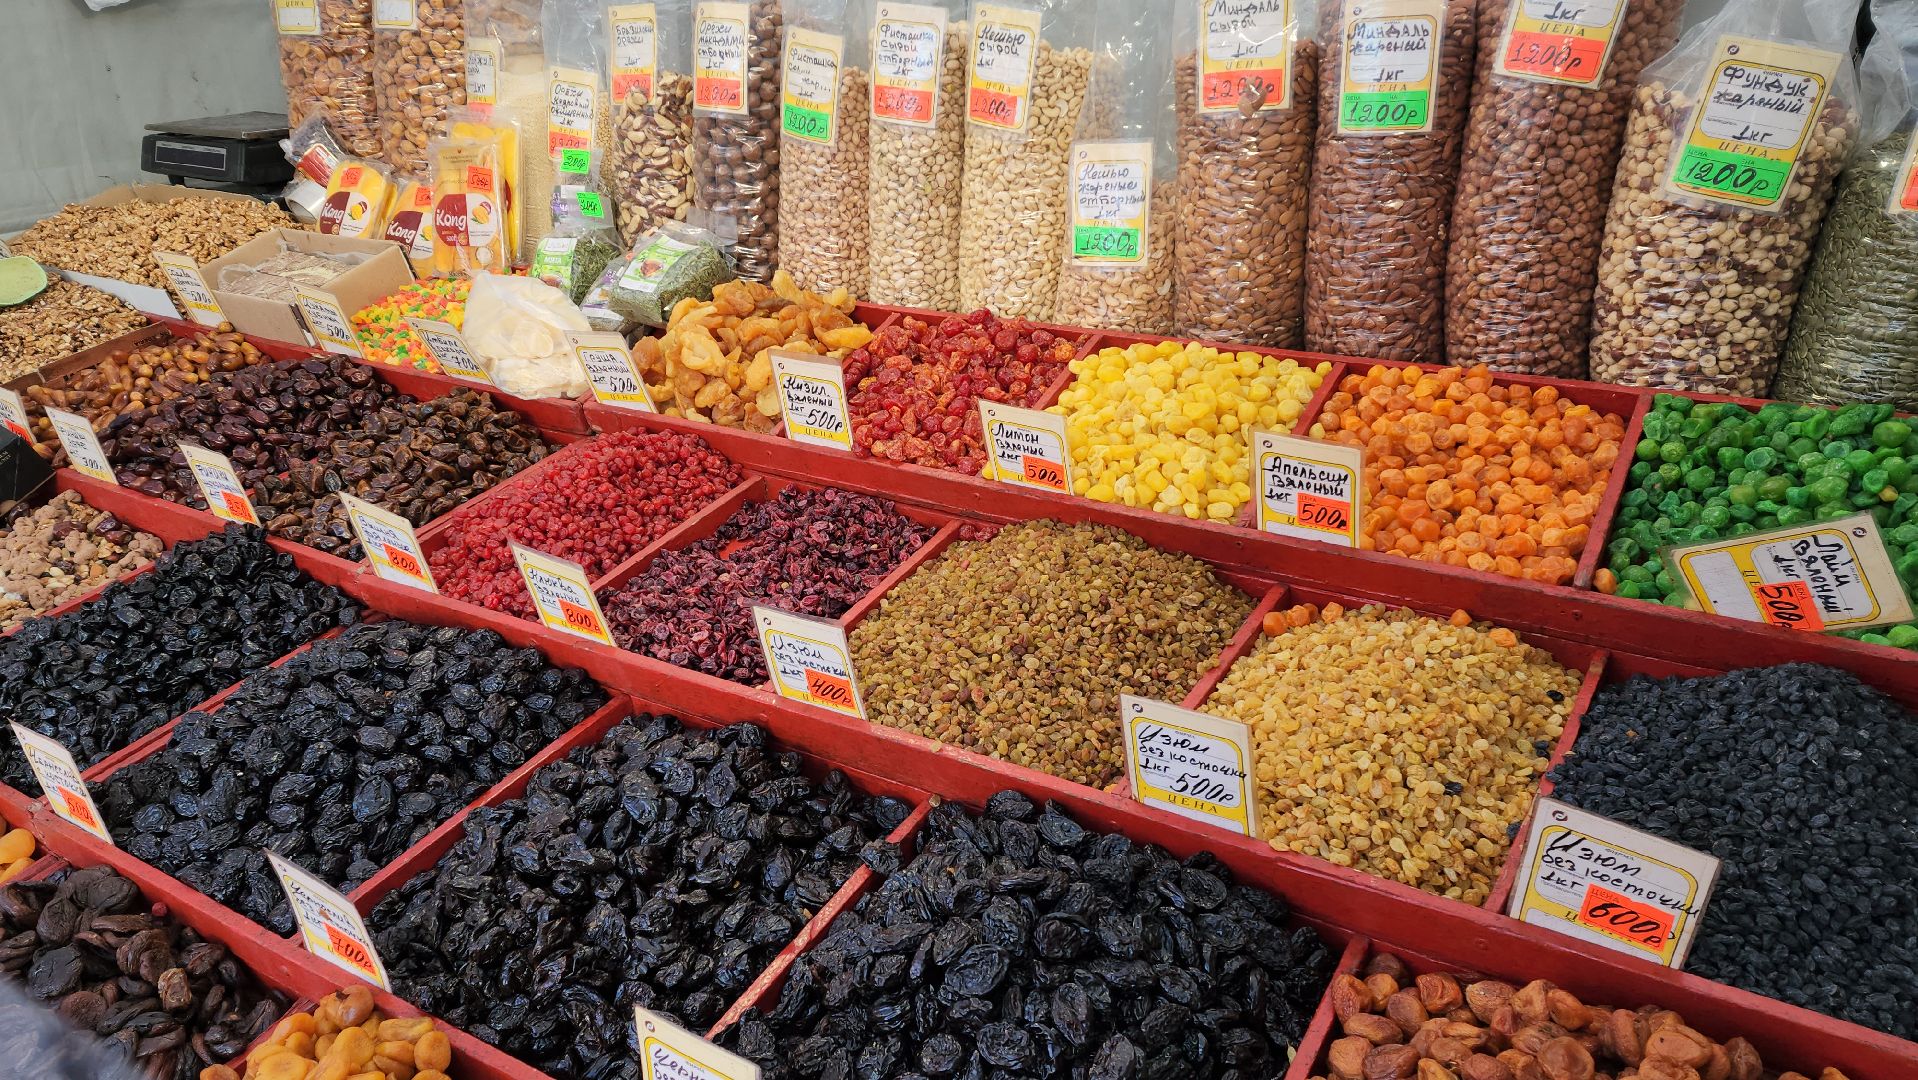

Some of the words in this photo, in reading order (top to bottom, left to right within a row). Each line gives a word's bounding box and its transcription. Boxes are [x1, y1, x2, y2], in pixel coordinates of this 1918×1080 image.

[1540, 22, 1585, 36] ЦЕНА
[1373, 68, 1404, 82] 1кг
[1368, 84, 1407, 92] ЦЕНА
[1345, 101, 1418, 125] 1200р
[1732, 126, 1773, 142] 1кг
[1719, 141, 1768, 158] ЦЕНА
[1079, 163, 1129, 180] Кешью
[1686, 163, 1769, 194] 1200р
[1080, 232, 1135, 257] 1200р
[610, 376, 637, 392] 500р
[789, 403, 804, 412] 1кг
[806, 408, 843, 431] 500р
[805, 428, 833, 438] ЦЕНА
[1028, 464, 1064, 486] 500р
[1302, 503, 1347, 529] 500р
[390, 548, 421, 575] 800р
[773, 634, 825, 661] Изюм
[812, 678, 851, 704] 400р
[1138, 724, 1210, 754] Изюм
[1139, 757, 1170, 773] 1кг
[1170, 773, 1234, 802] 500р
[1167, 794, 1218, 814] ЦЕНА
[1541, 847, 1576, 872] без
[1550, 830, 1642, 877] Изюм
[1541, 871, 1584, 889] 1кг
[1588, 902, 1663, 944] 600р
[330, 934, 372, 968] 700р
